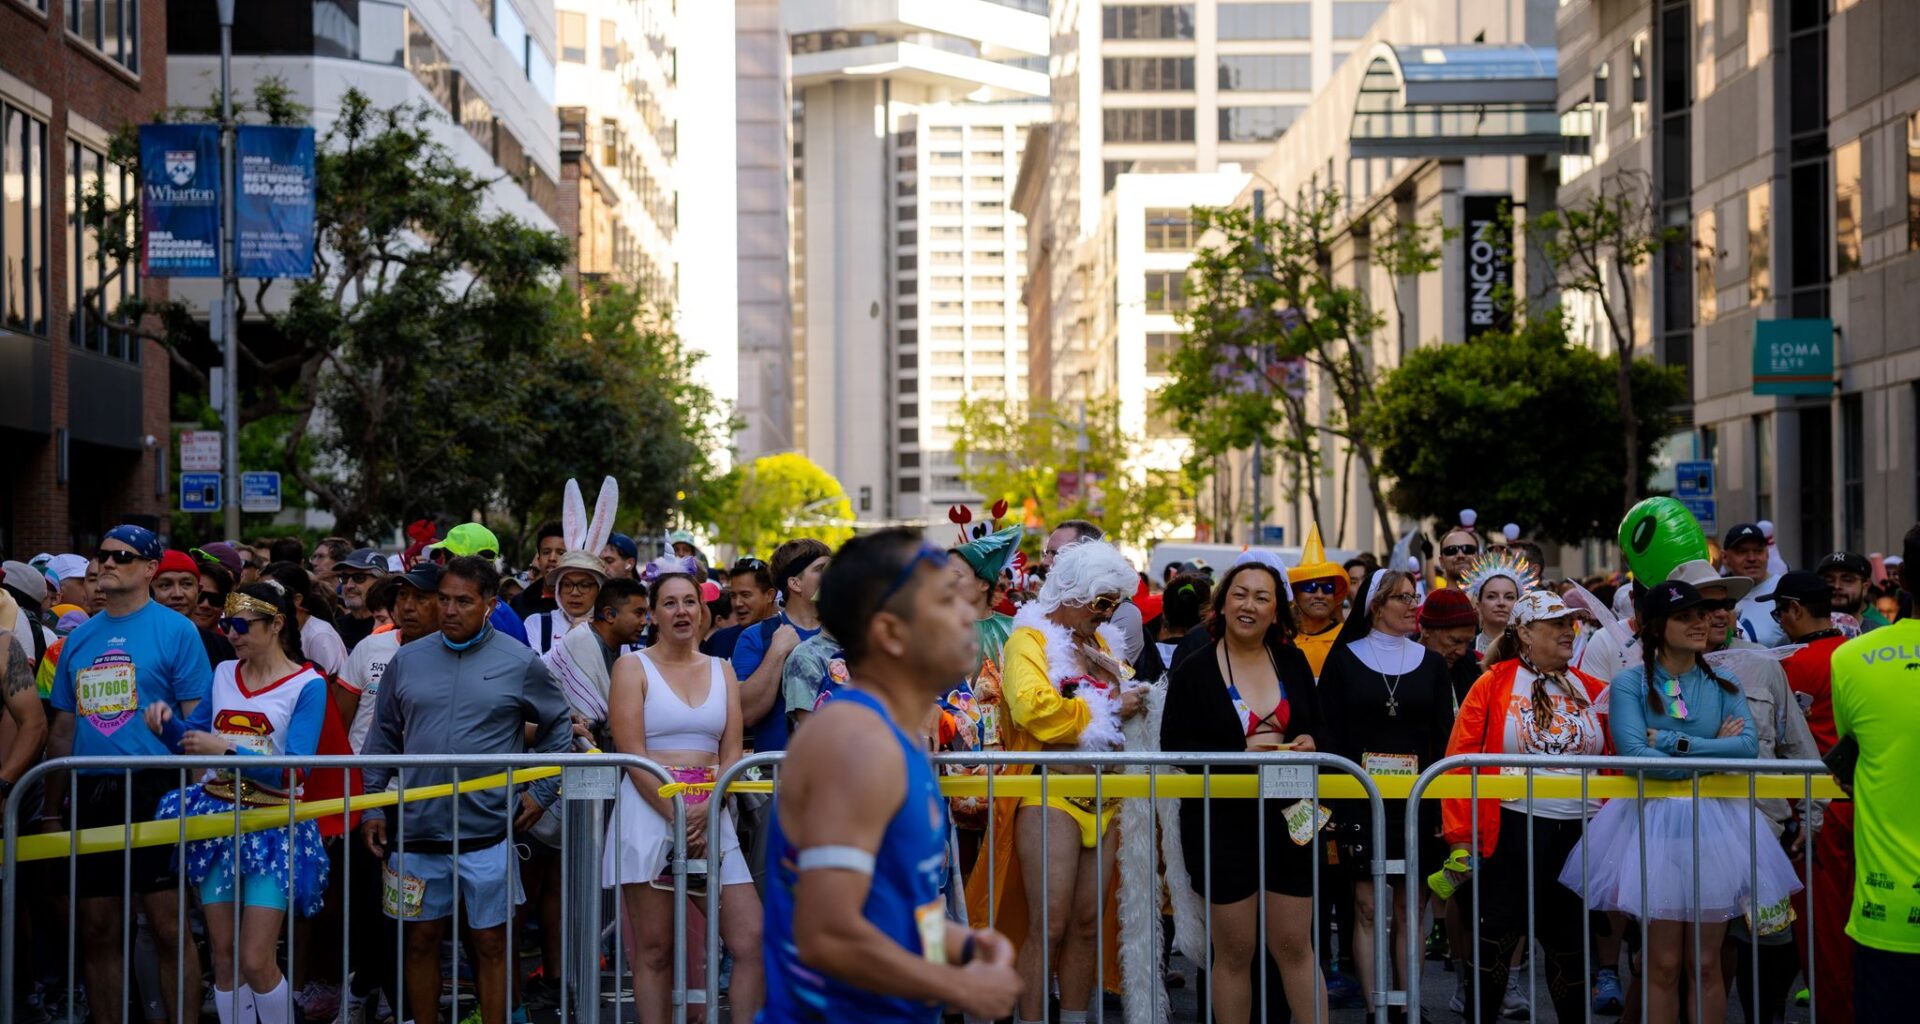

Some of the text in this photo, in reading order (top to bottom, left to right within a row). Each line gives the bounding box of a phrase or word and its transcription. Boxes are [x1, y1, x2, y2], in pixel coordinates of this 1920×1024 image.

[243, 173, 303, 183] NETWORK
[148, 185, 215, 201] Wharton
[149, 239, 202, 249] PROGRAM
[148, 248, 216, 258] EXECUTIVES
[1470, 220, 1494, 325] RINCON
[1770, 343, 1820, 357] SOMA
[183, 477, 198, 485] Pay
